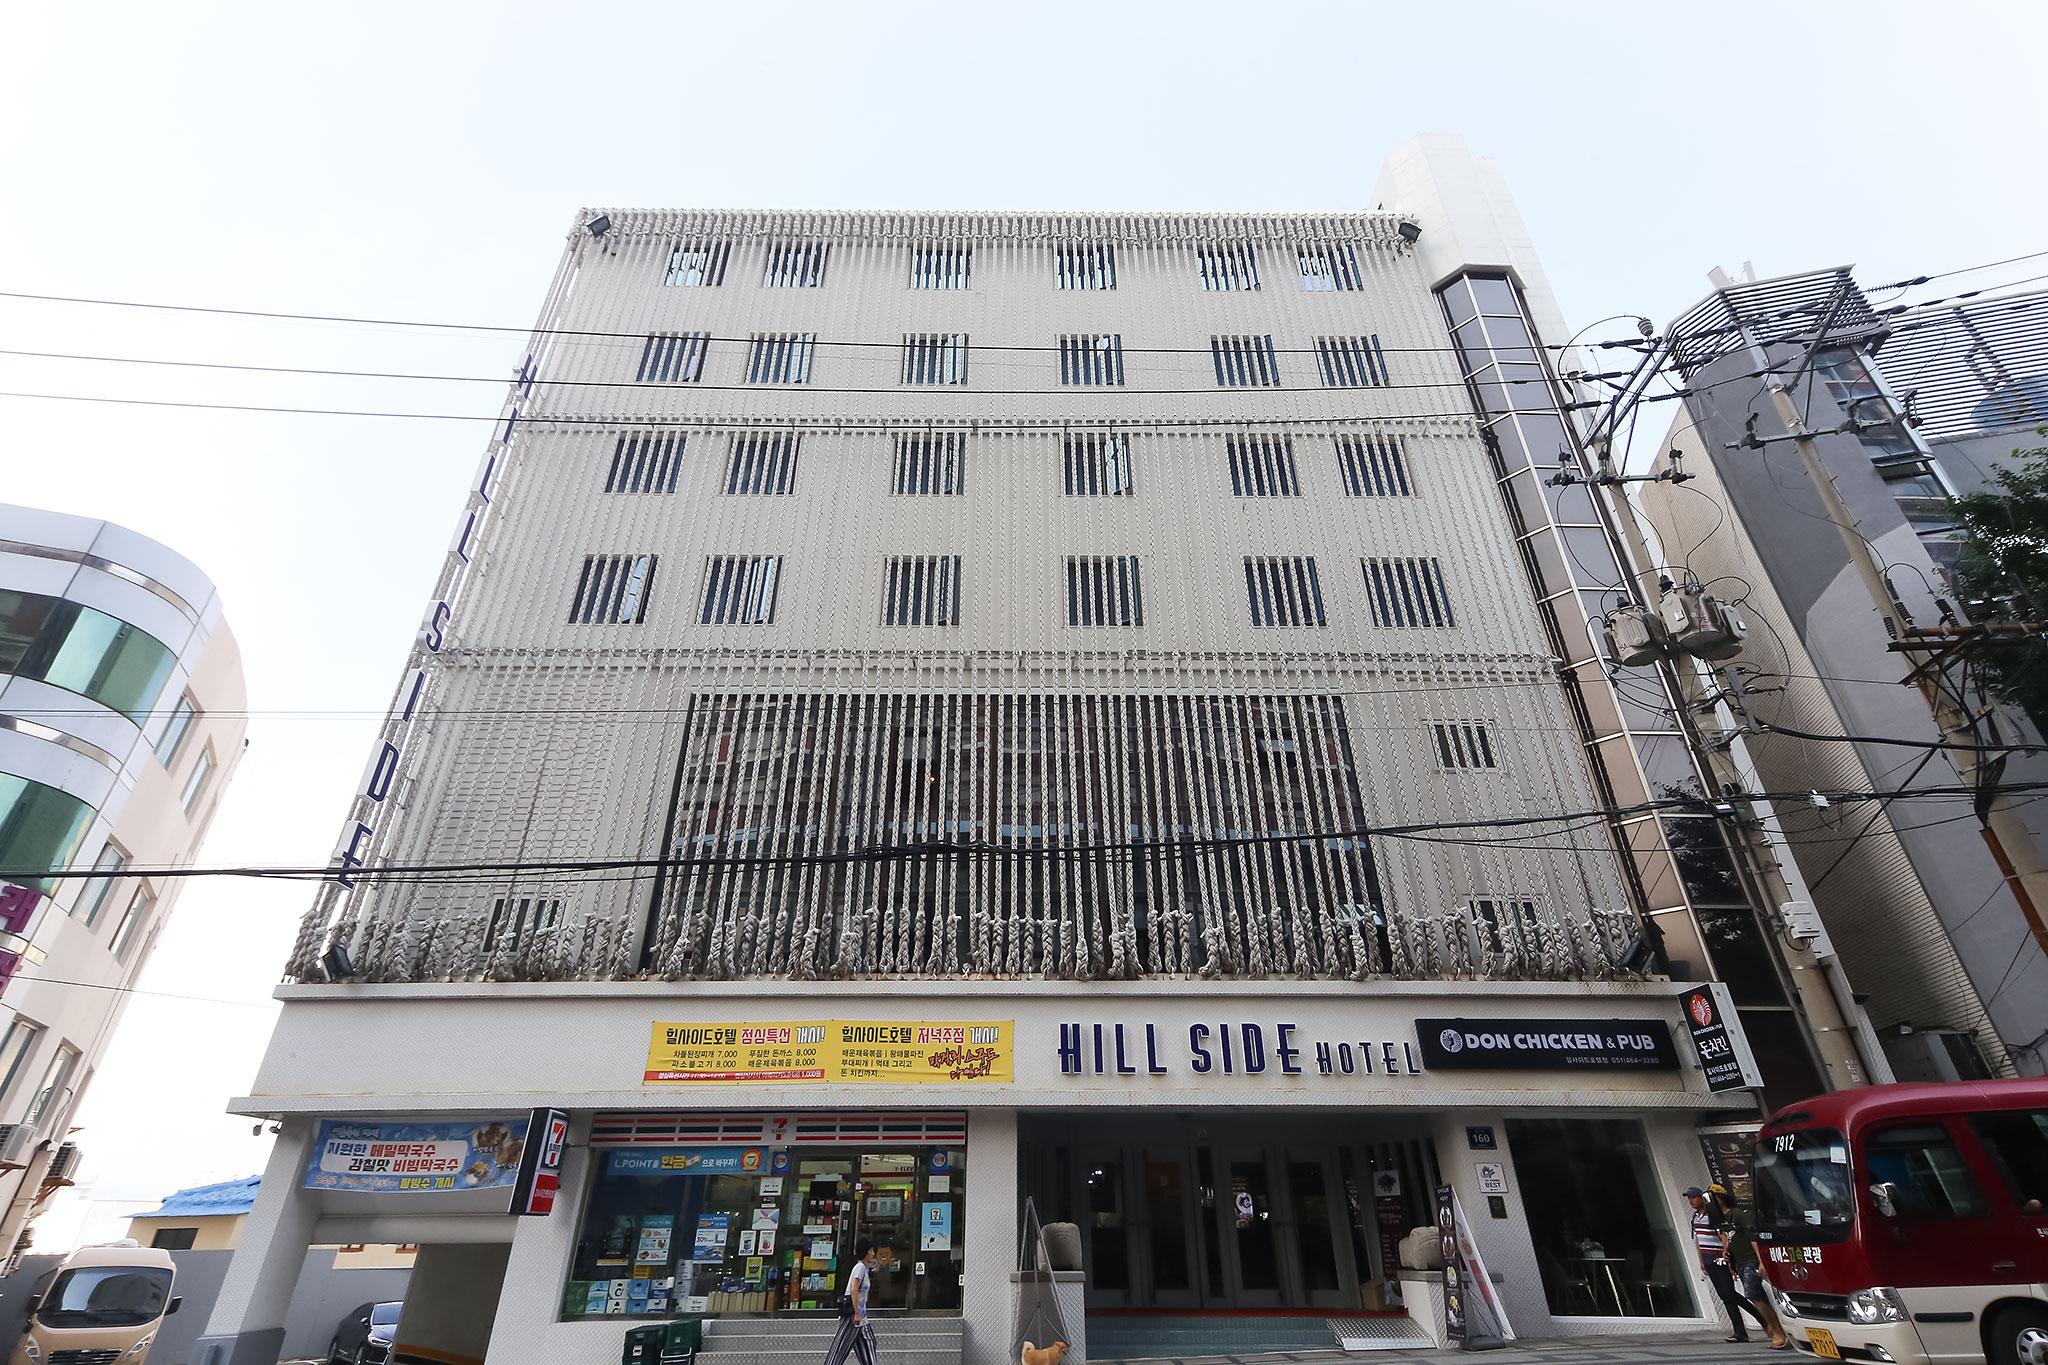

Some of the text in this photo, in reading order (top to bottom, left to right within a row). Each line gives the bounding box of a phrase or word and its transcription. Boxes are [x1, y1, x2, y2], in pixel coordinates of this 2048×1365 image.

[666, 1026, 826, 1045] 힐사이드호텔 점심특선 개시!
[841, 1026, 999, 1044] 힐사이드호텔 저녁주점 개시!
[1465, 1033, 1655, 1050] DON CHICKEN & PUB
[772, 1049, 793, 1057] 돈까스
[1057, 1022, 1422, 1076] HILL SIDE HOTEL
[1699, 1035, 1729, 1060] 돈치킨
[891, 1060, 912, 1068] 그리고
[1472, 1133, 1491, 1143] 160
[1775, 1134, 1795, 1152] 7912
[327, 1142, 436, 1158] 시원한 메밀막국수
[348, 1158, 459, 1172] 감칠맛 비빔막국수
[661, 1155, 687, 1170] 현금
[433, 1176, 455, 1188] 개시
